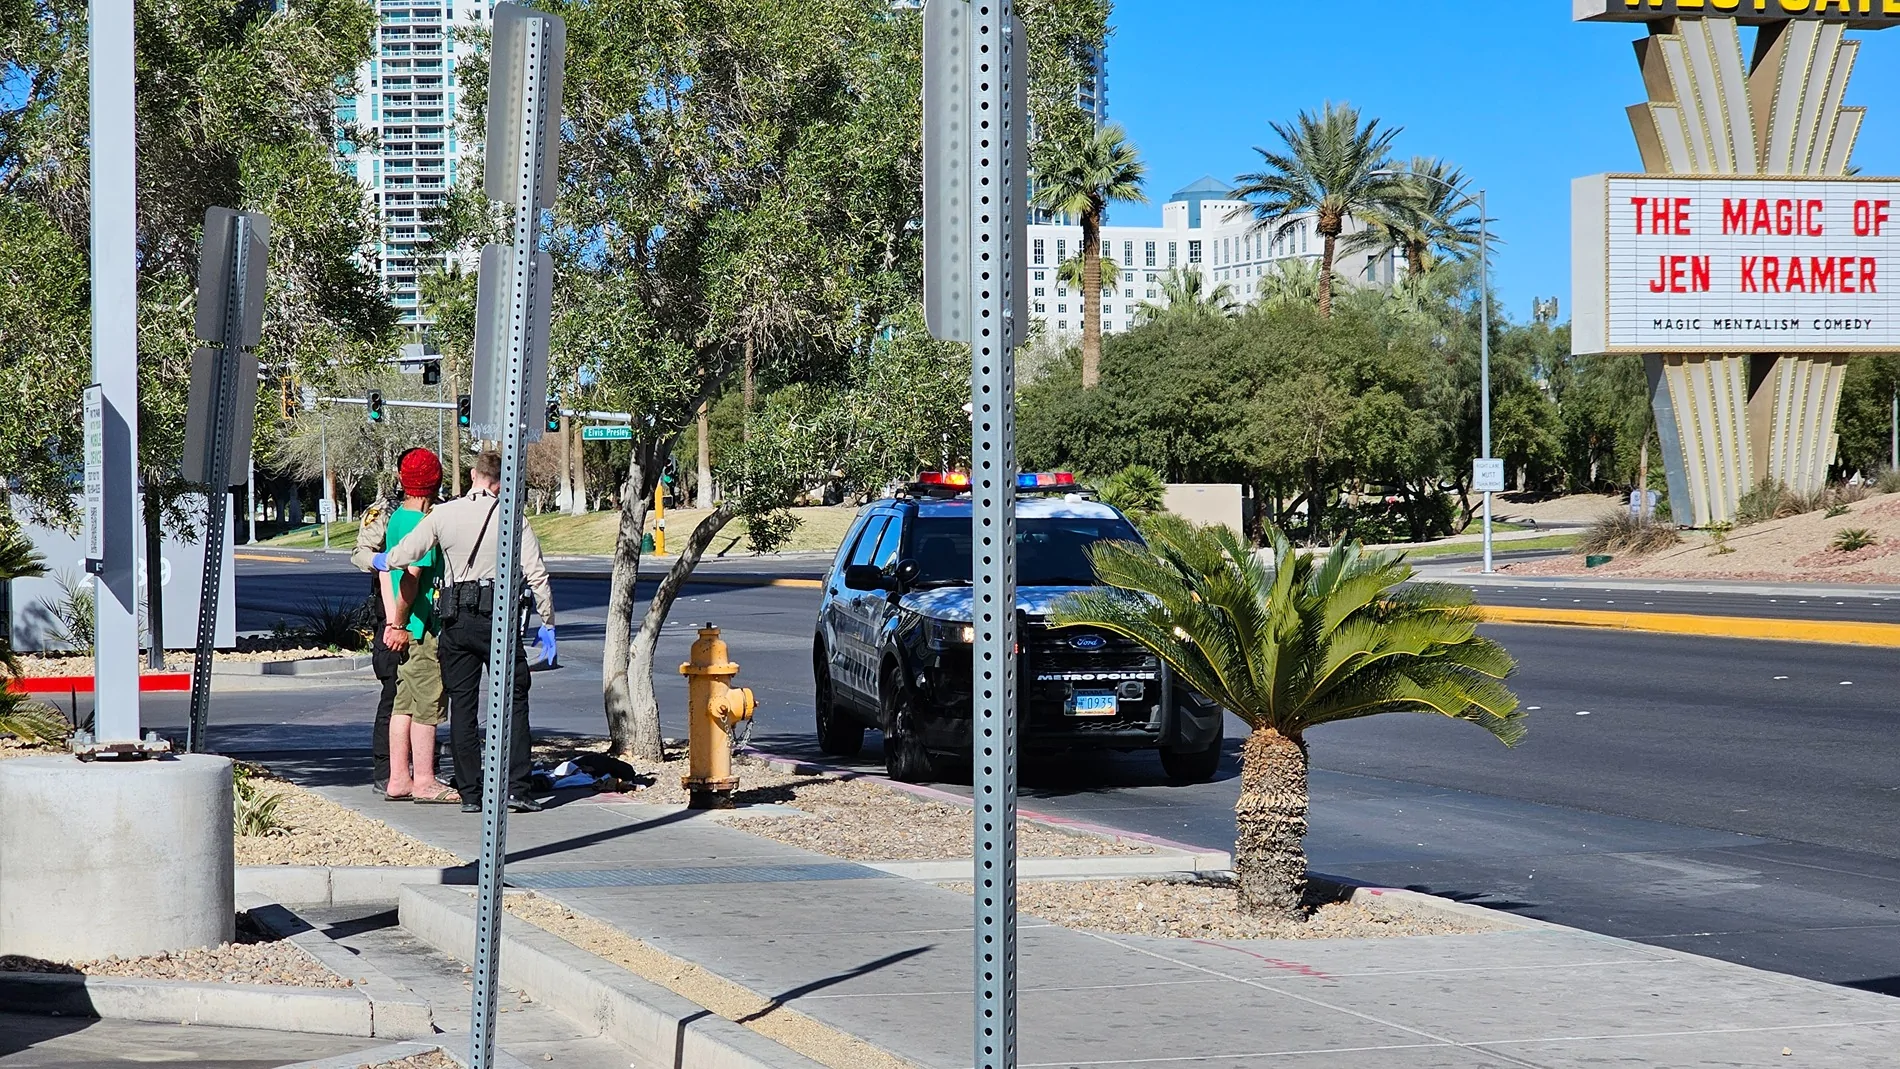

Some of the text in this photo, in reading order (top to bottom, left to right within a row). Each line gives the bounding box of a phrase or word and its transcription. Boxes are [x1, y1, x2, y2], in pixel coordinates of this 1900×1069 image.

[1631, 197, 1890, 237] THE MAGIC OF
[1649, 255, 1877, 294] JEN KRAMER
[1653, 318, 1872, 331] MAGIC MENTALISM COMEDY
[588, 428, 629, 438] Elvis Presley
[1076, 638, 1098, 646] Ford
[1096, 673, 1156, 681] POLICE
[1087, 697, 1113, 710] 0935
